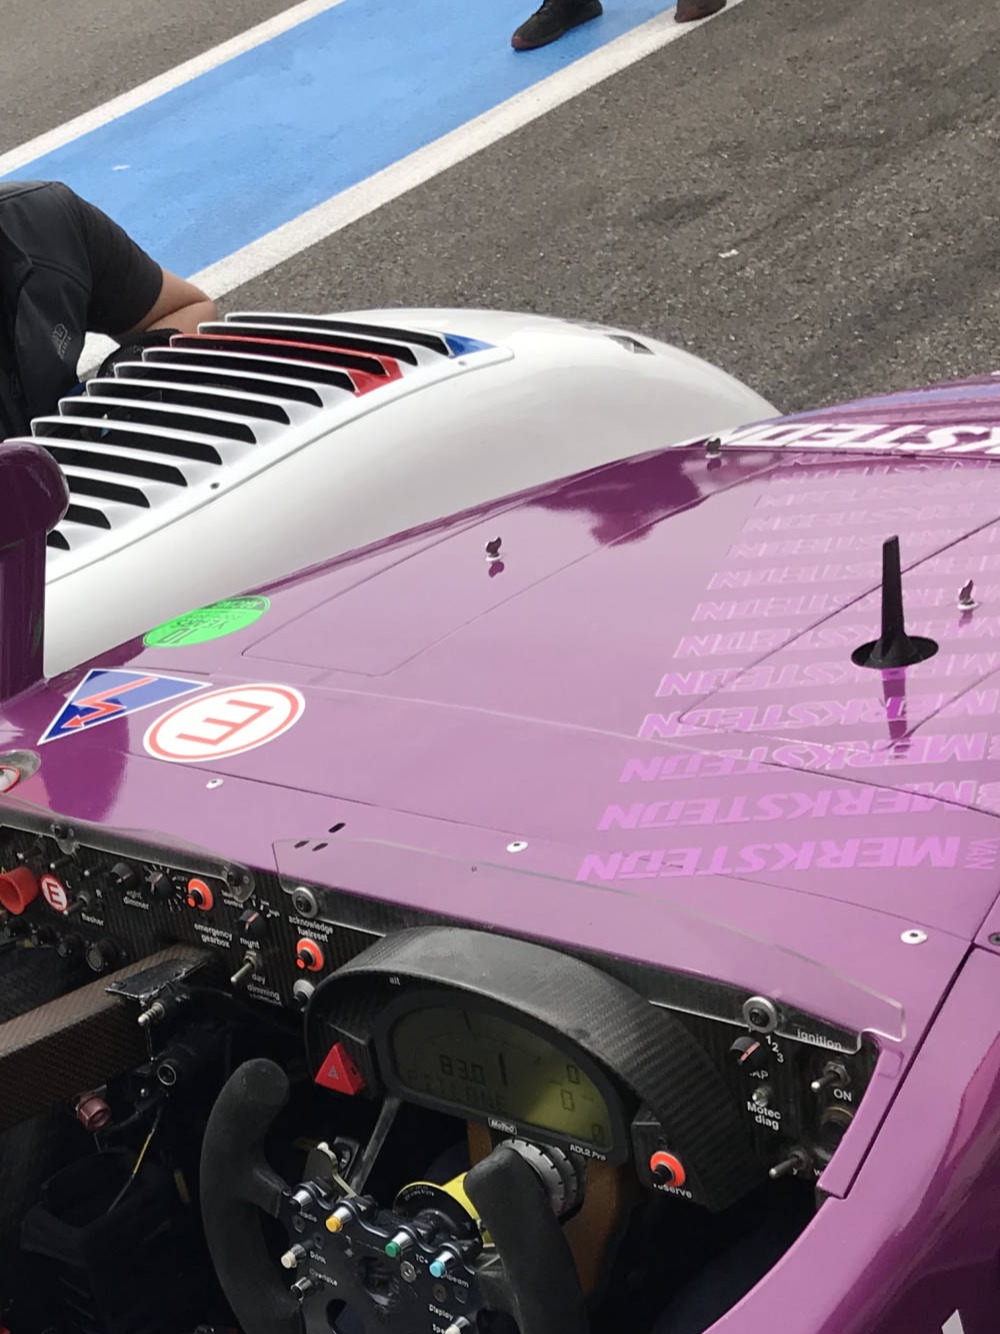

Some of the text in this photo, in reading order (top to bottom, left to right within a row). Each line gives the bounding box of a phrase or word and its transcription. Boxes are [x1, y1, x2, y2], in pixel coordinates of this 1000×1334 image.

[575, 836, 960, 882] MERKSTEIJN
[194, 923, 233, 941] emergency
[289, 915, 334, 934] acknowledge
[201, 934, 231, 948] gearbox
[797, 1028, 842, 1050] ignition
[833, 1088, 852, 1101] ON
[747, 1102, 781, 1120] Motec
[755, 1113, 779, 1131] diag
[428, 1303, 454, 1321] Display
